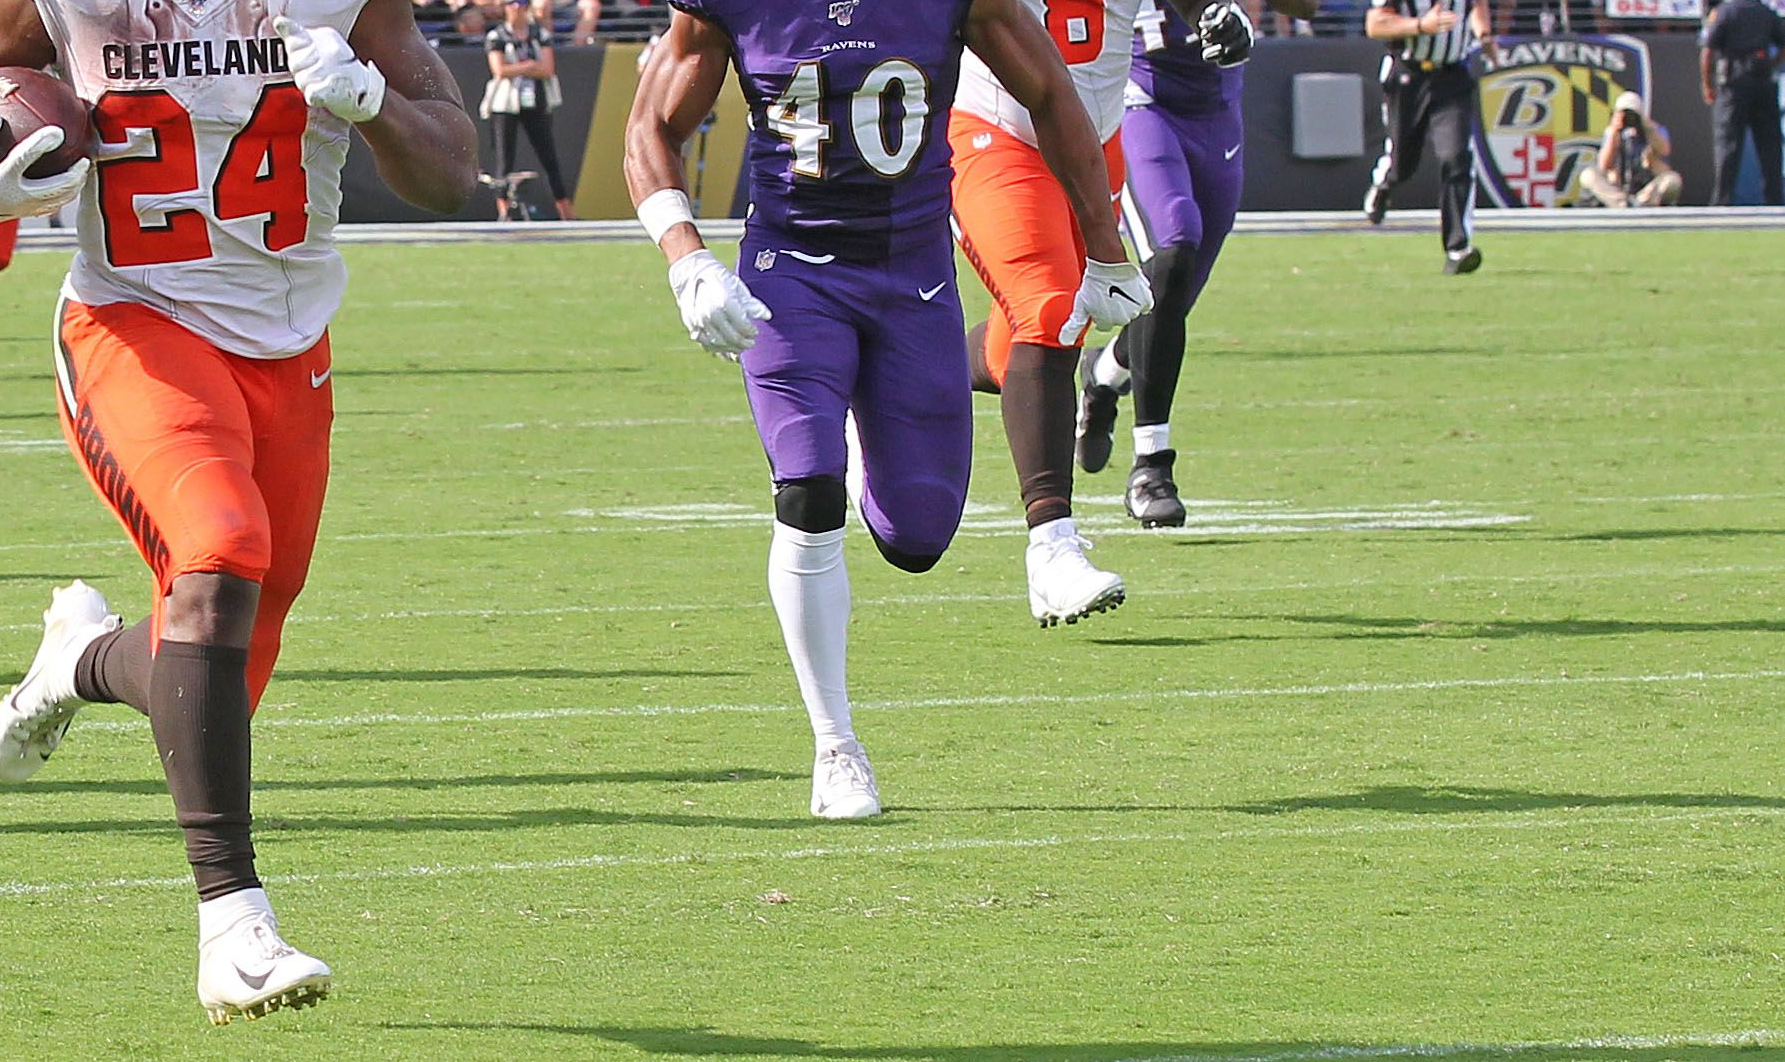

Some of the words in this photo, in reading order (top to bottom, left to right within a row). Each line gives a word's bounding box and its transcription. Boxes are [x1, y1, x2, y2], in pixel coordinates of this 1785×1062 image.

[102, 37, 290, 81] CLEVELAND
[821, 40, 877, 53] RAVENS
[766, 57, 931, 179] 40
[97, 81, 309, 268] 24
